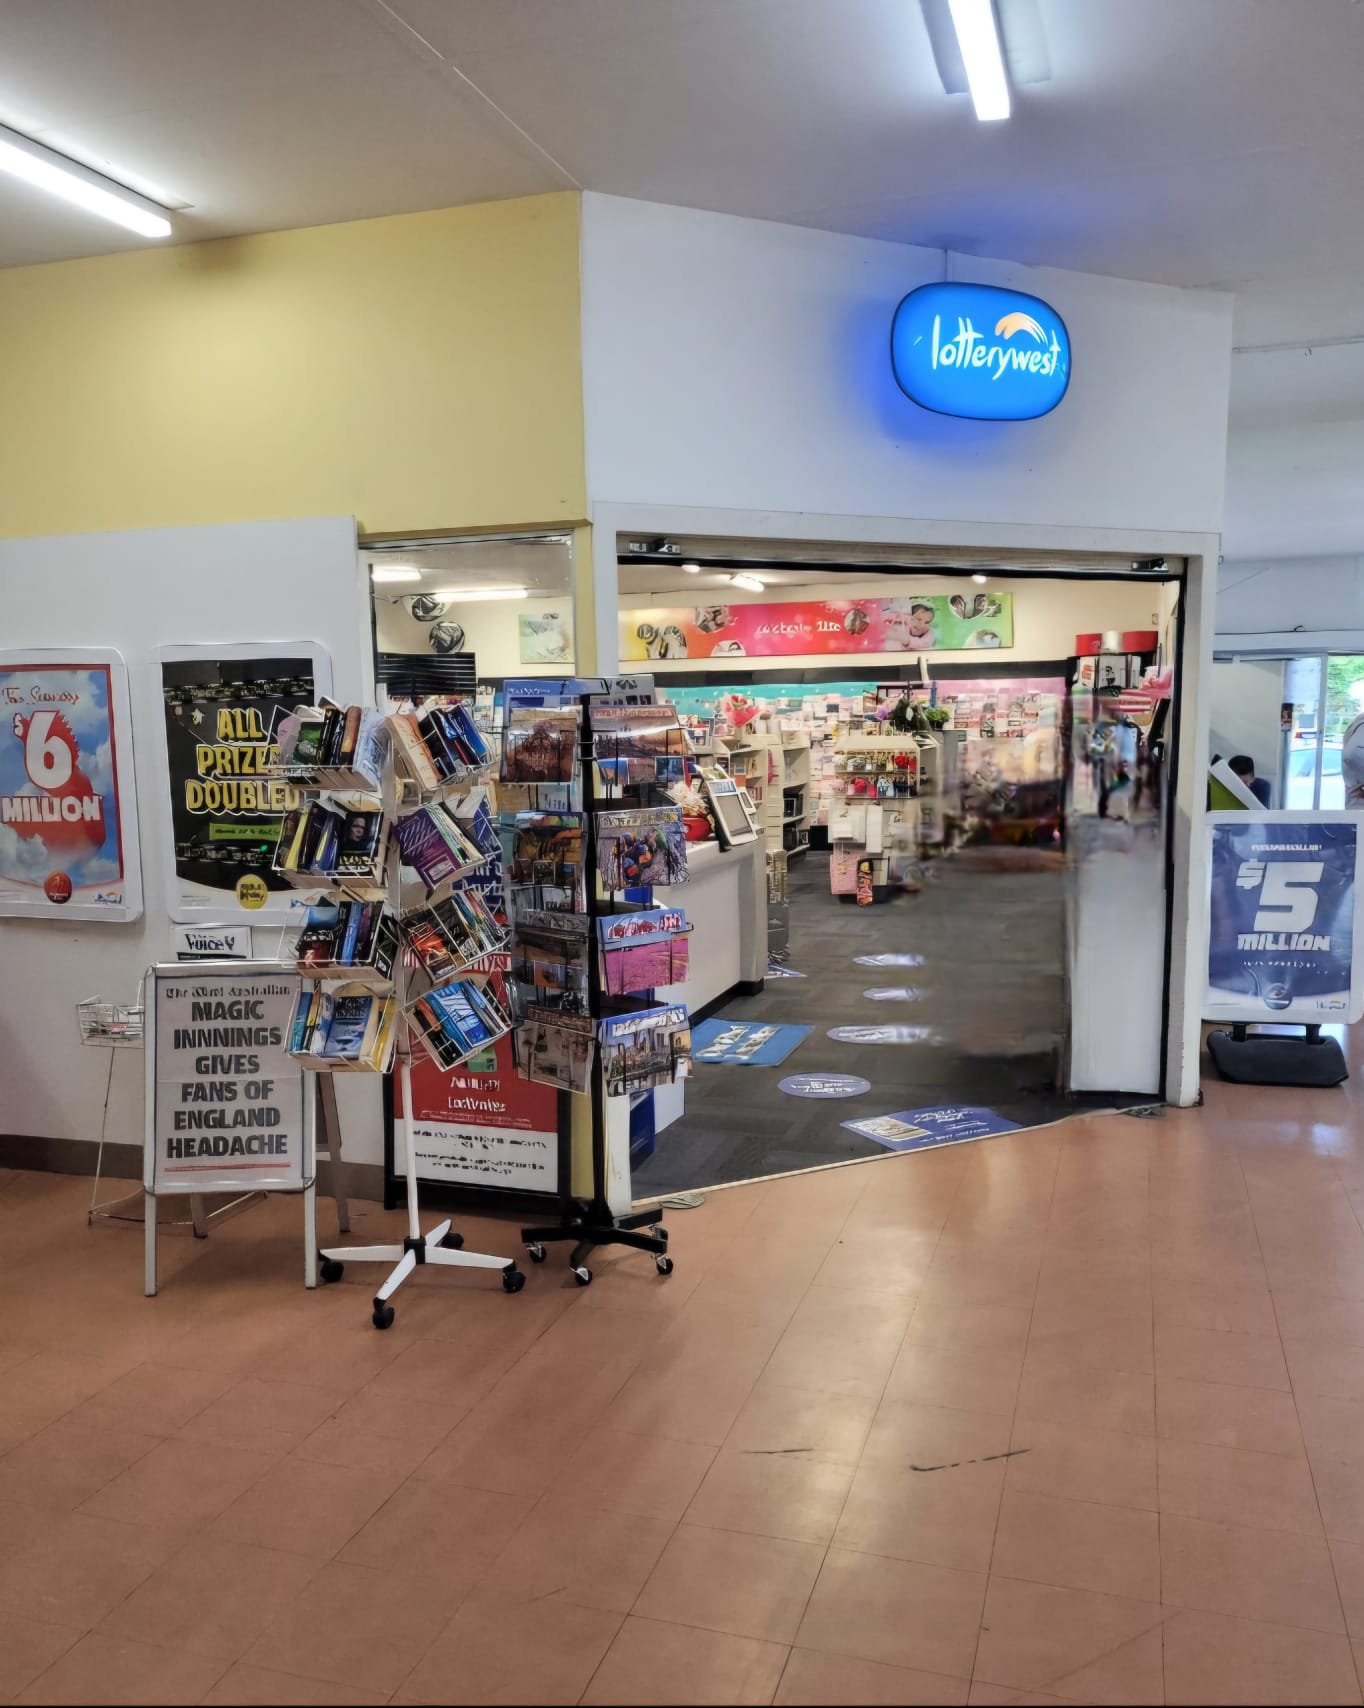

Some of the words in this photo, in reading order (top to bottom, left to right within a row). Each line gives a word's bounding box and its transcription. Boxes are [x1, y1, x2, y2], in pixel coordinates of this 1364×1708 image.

[931, 314, 1062, 381] lotterywest
[218, 707, 264, 739] ALL
[1, 796, 103, 823] MILLION
[1236, 859, 1325, 933] $5
[1237, 934, 1331, 951] MILLION
[191, 1000, 264, 1022] MAGIC
[195, 1054, 260, 1075] GIVES
[181, 1081, 237, 1103] FANS
[244, 1079, 274, 1100] OF
[174, 1107, 281, 1130] ENGLAND
[167, 1134, 288, 1158] HEADACHE
